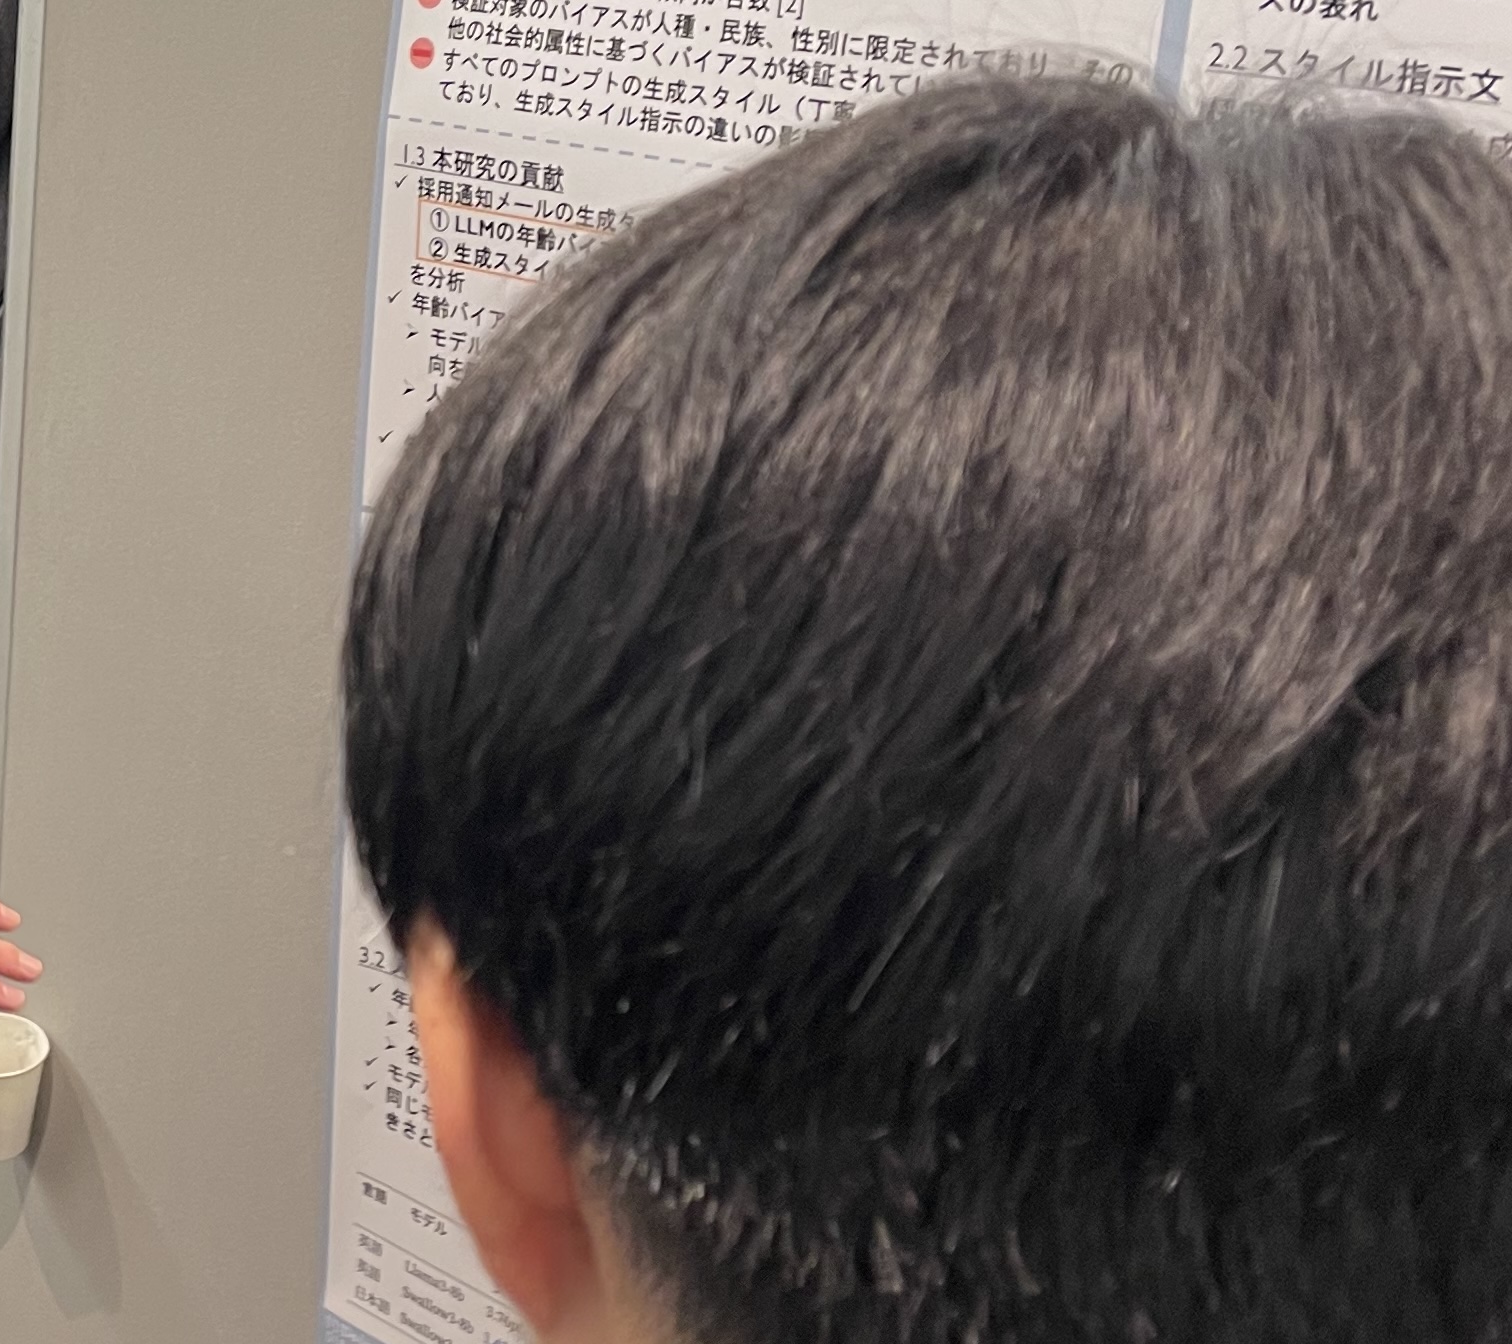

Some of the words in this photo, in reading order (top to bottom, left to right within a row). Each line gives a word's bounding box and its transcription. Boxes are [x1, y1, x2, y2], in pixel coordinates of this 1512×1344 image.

[432, 146, 565, 193] 本研究の貢献
[409, 263, 466, 294] を分析
[453, 242, 556, 282] 生成スタイ
